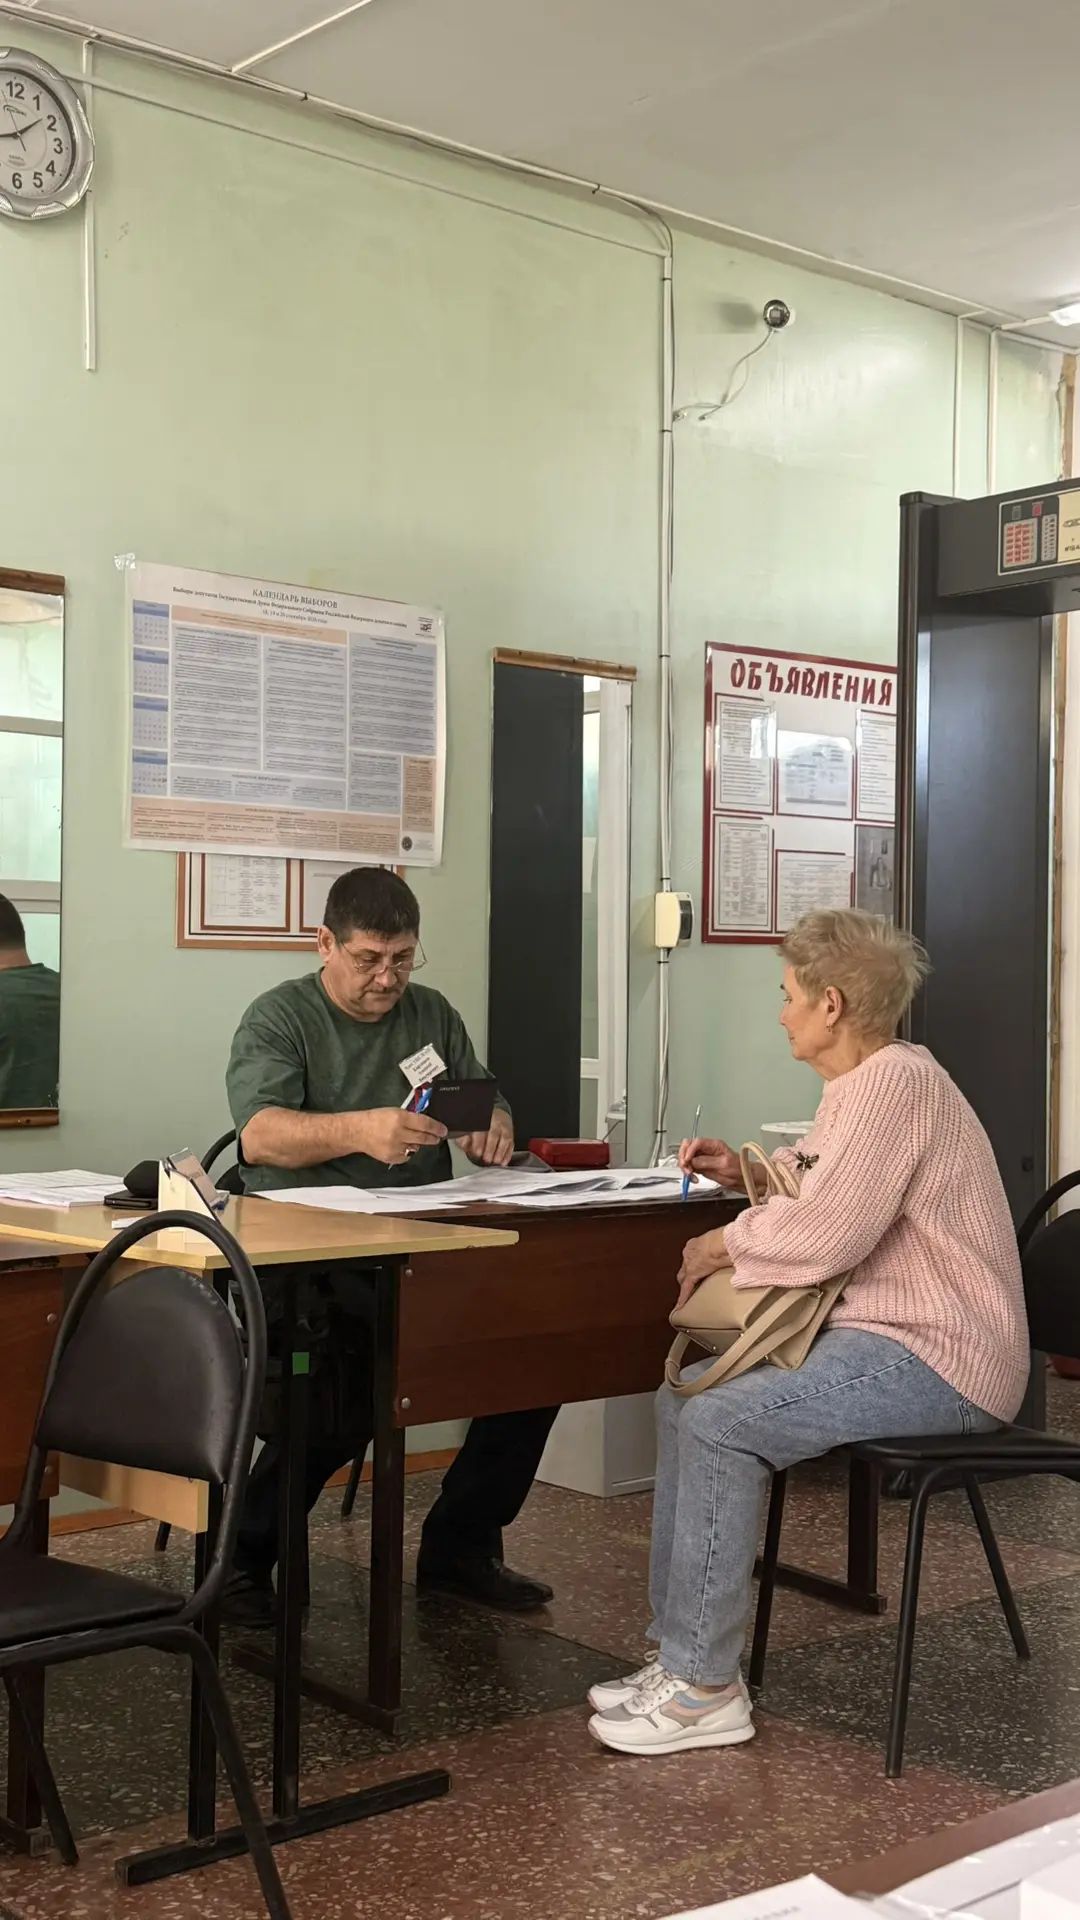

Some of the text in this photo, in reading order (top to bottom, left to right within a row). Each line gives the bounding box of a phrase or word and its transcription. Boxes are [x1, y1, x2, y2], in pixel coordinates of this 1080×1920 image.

[6, 80, 25, 100] 12
[32, 94, 41, 111] 1
[47, 115, 57, 132] 2
[53, 138, 64, 155] 3
[45, 160, 57, 177] 4
[12, 172, 23, 190] 6
[32, 172, 43, 189] 5
[252, 588, 338, 609] КАЛЕНДАРЬ ВЫБОРОВ
[730, 658, 893, 706] ОБЪЯВЛЕНИЯ
